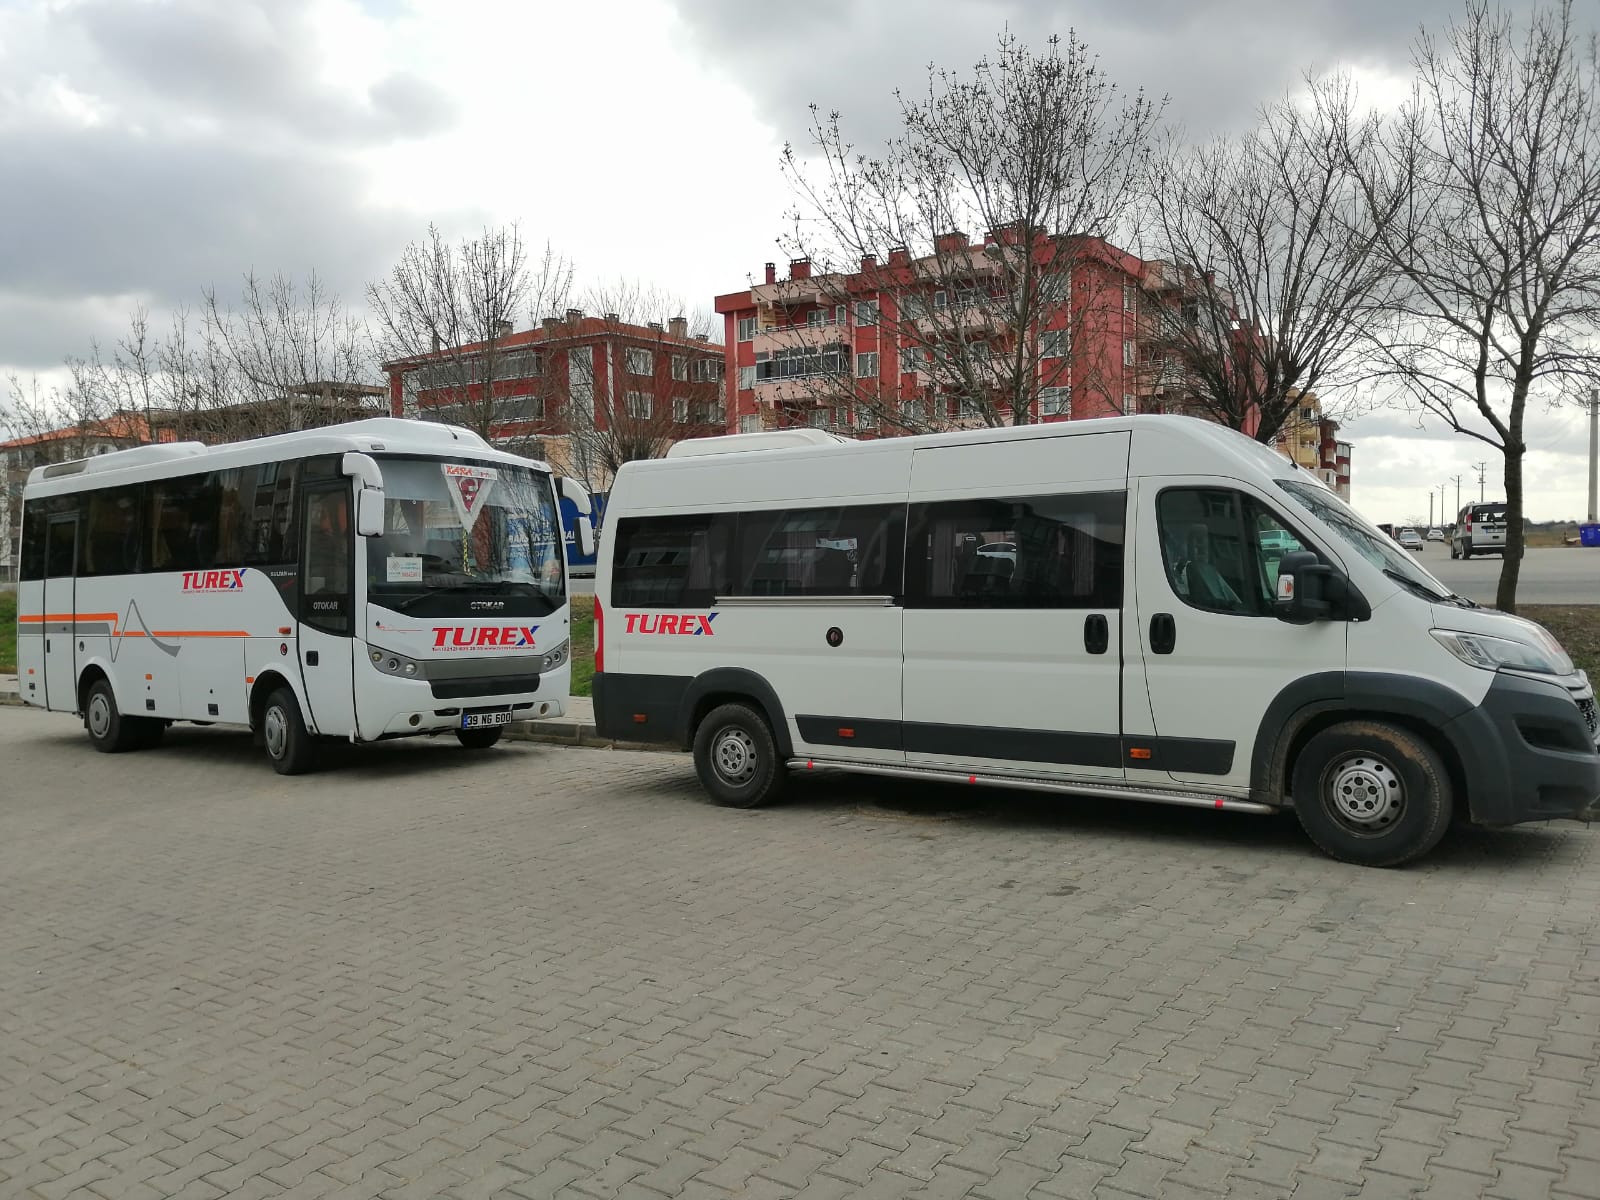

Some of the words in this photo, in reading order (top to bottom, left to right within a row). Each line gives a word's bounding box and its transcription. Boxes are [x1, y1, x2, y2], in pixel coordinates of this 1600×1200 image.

[182, 568, 248, 590] TUREX
[313, 600, 338, 610] OTOKAR
[470, 601, 505, 610] OTOKAR
[624, 612, 720, 636] TUREX
[432, 625, 540, 647] TUREX
[467, 715, 478, 725] 39
[481, 714, 492, 724] NG
[495, 712, 511, 723] 600
